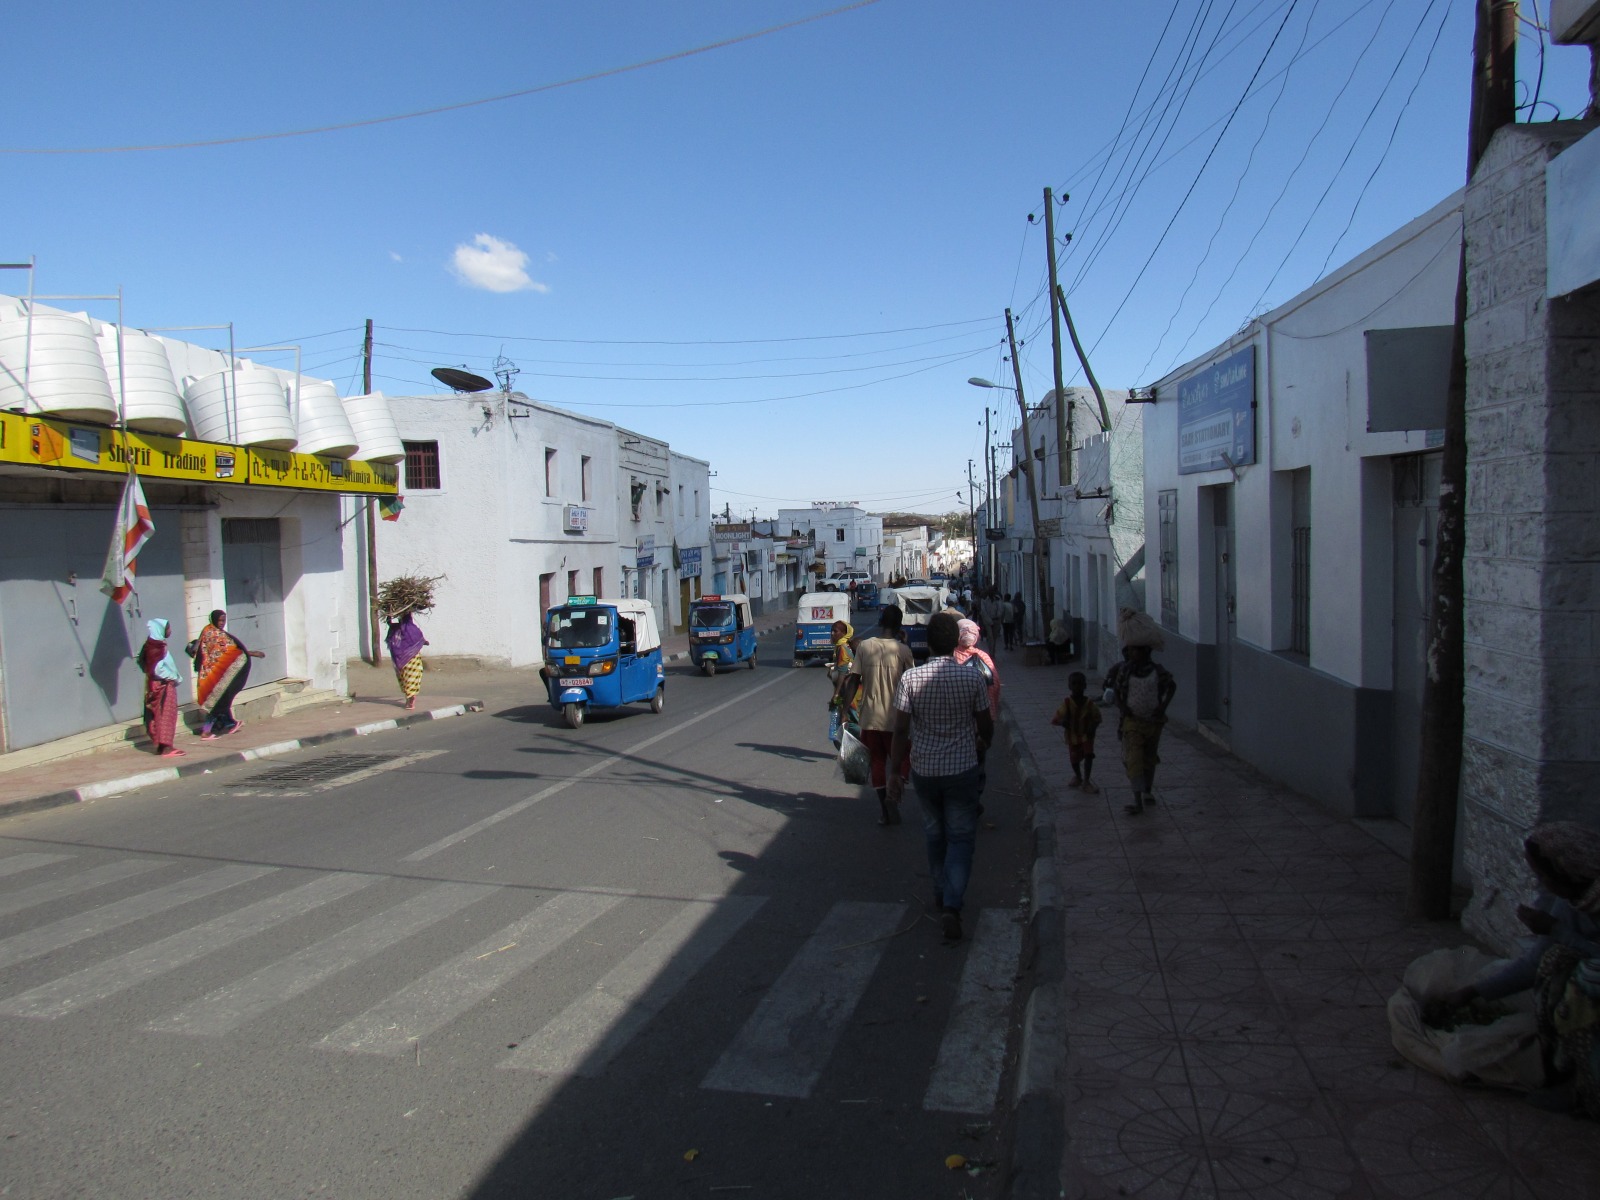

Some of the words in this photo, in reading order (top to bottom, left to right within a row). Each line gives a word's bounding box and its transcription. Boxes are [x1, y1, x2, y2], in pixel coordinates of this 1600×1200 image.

[109, 443, 151, 466] Sherif
[162, 450, 206, 474] Trading
[812, 608, 833, 619] 024
